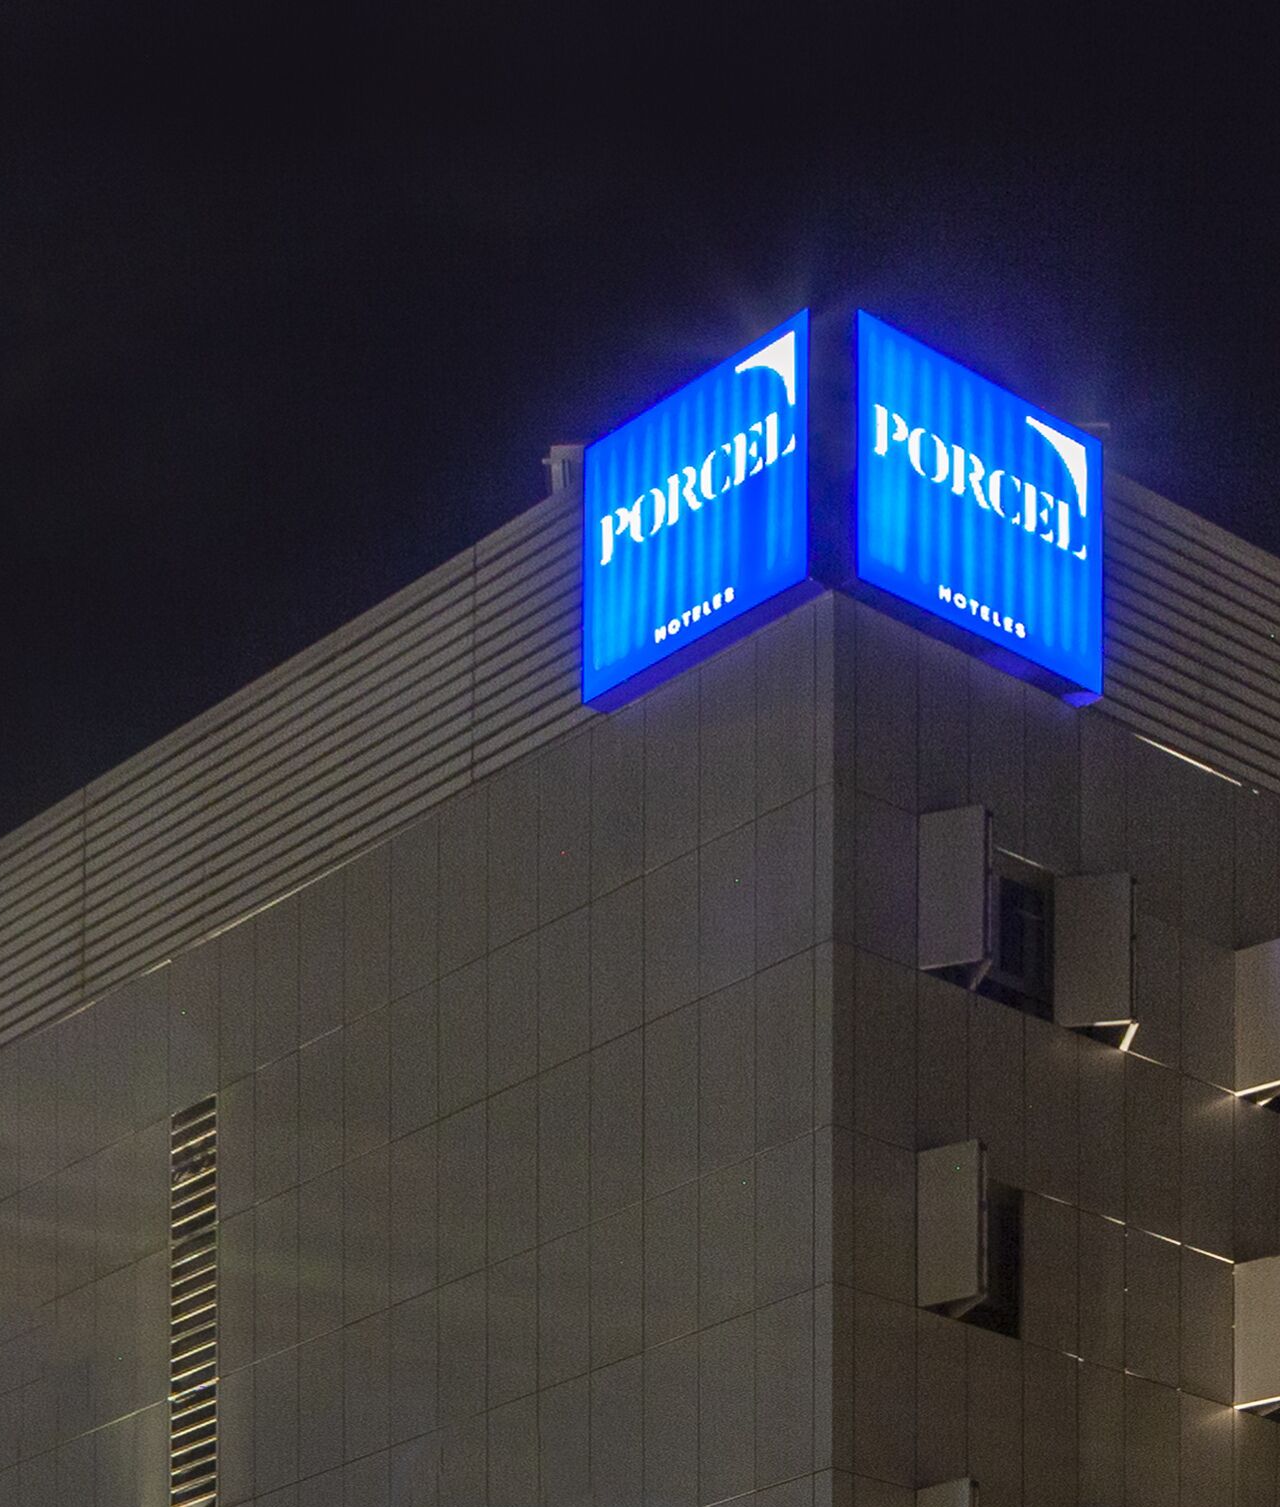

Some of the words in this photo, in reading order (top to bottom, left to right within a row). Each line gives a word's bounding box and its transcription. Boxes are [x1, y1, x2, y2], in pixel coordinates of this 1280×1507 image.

[600, 411, 797, 567] PORCEL
[874, 403, 1088, 561] PORCEL
[654, 586, 735, 644] HOTELES
[938, 584, 1027, 639] HOTELES
